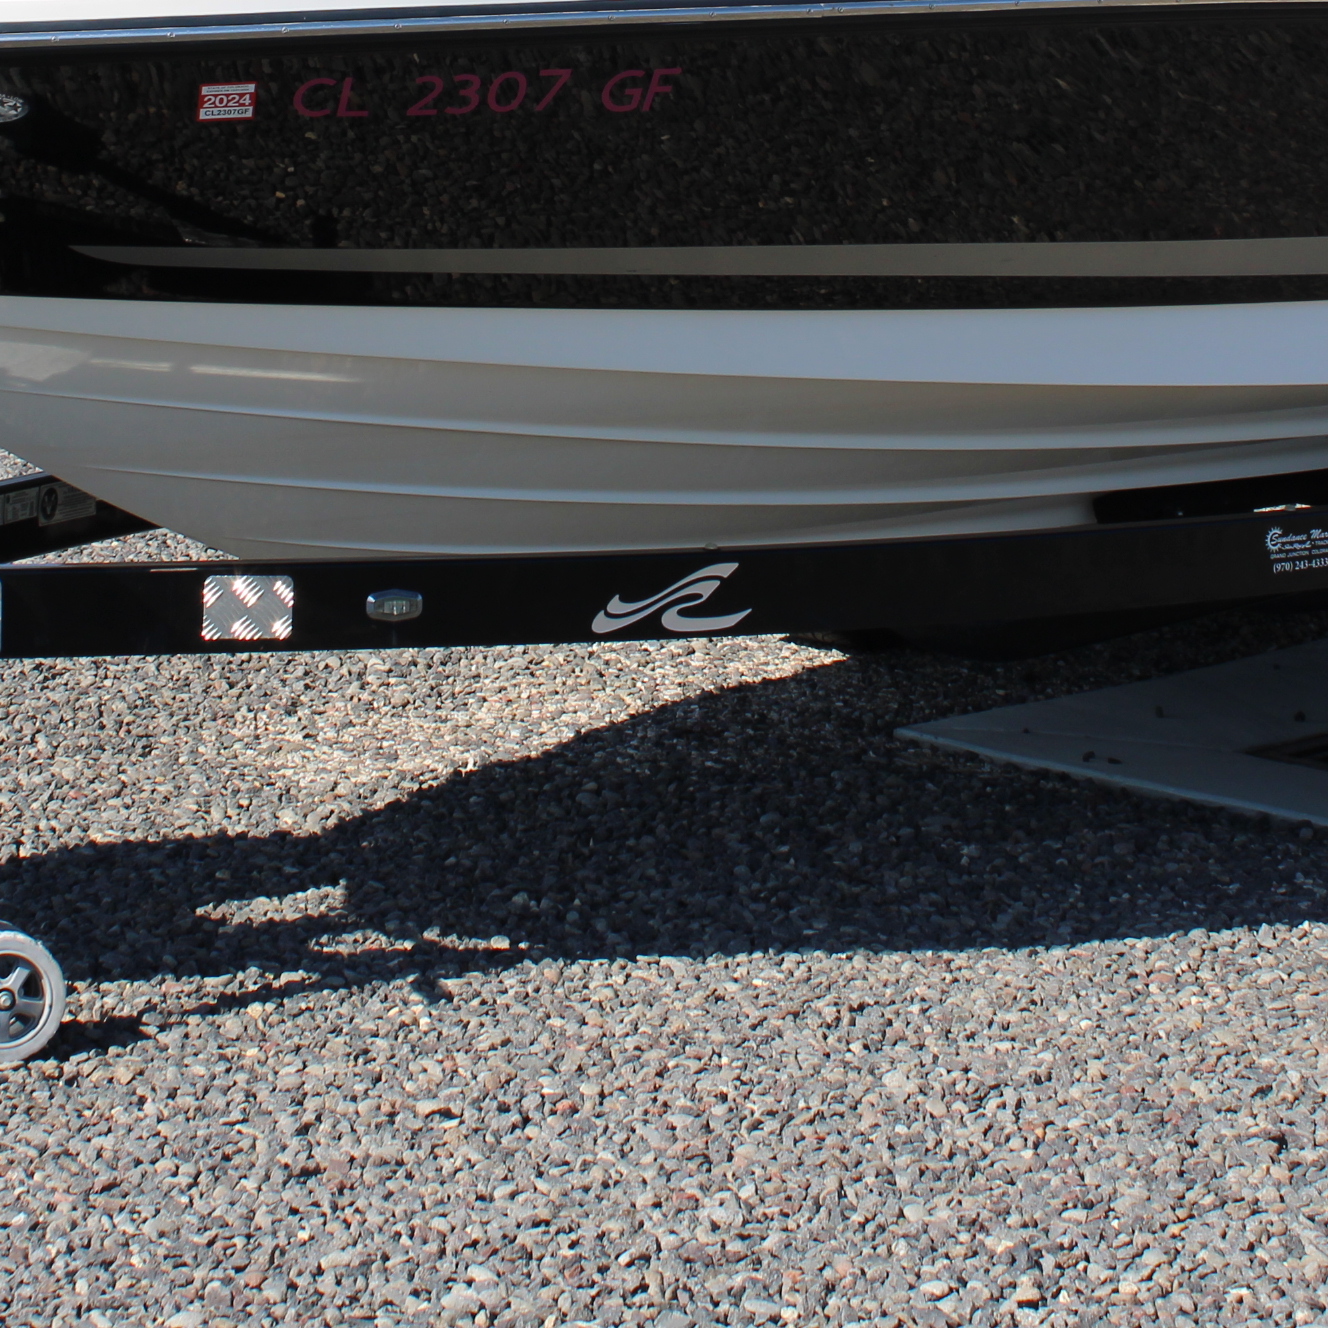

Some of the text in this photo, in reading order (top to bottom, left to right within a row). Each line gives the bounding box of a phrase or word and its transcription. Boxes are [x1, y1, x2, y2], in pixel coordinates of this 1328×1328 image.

[293, 67, 682, 118] CL 2307 GF
[203, 94, 252, 108] 2024
[204, 108, 250, 117] CL2307GF
[1271, 533, 1307, 544] Sundance
[1273, 557, 1328, 574] (970) 243-4333
